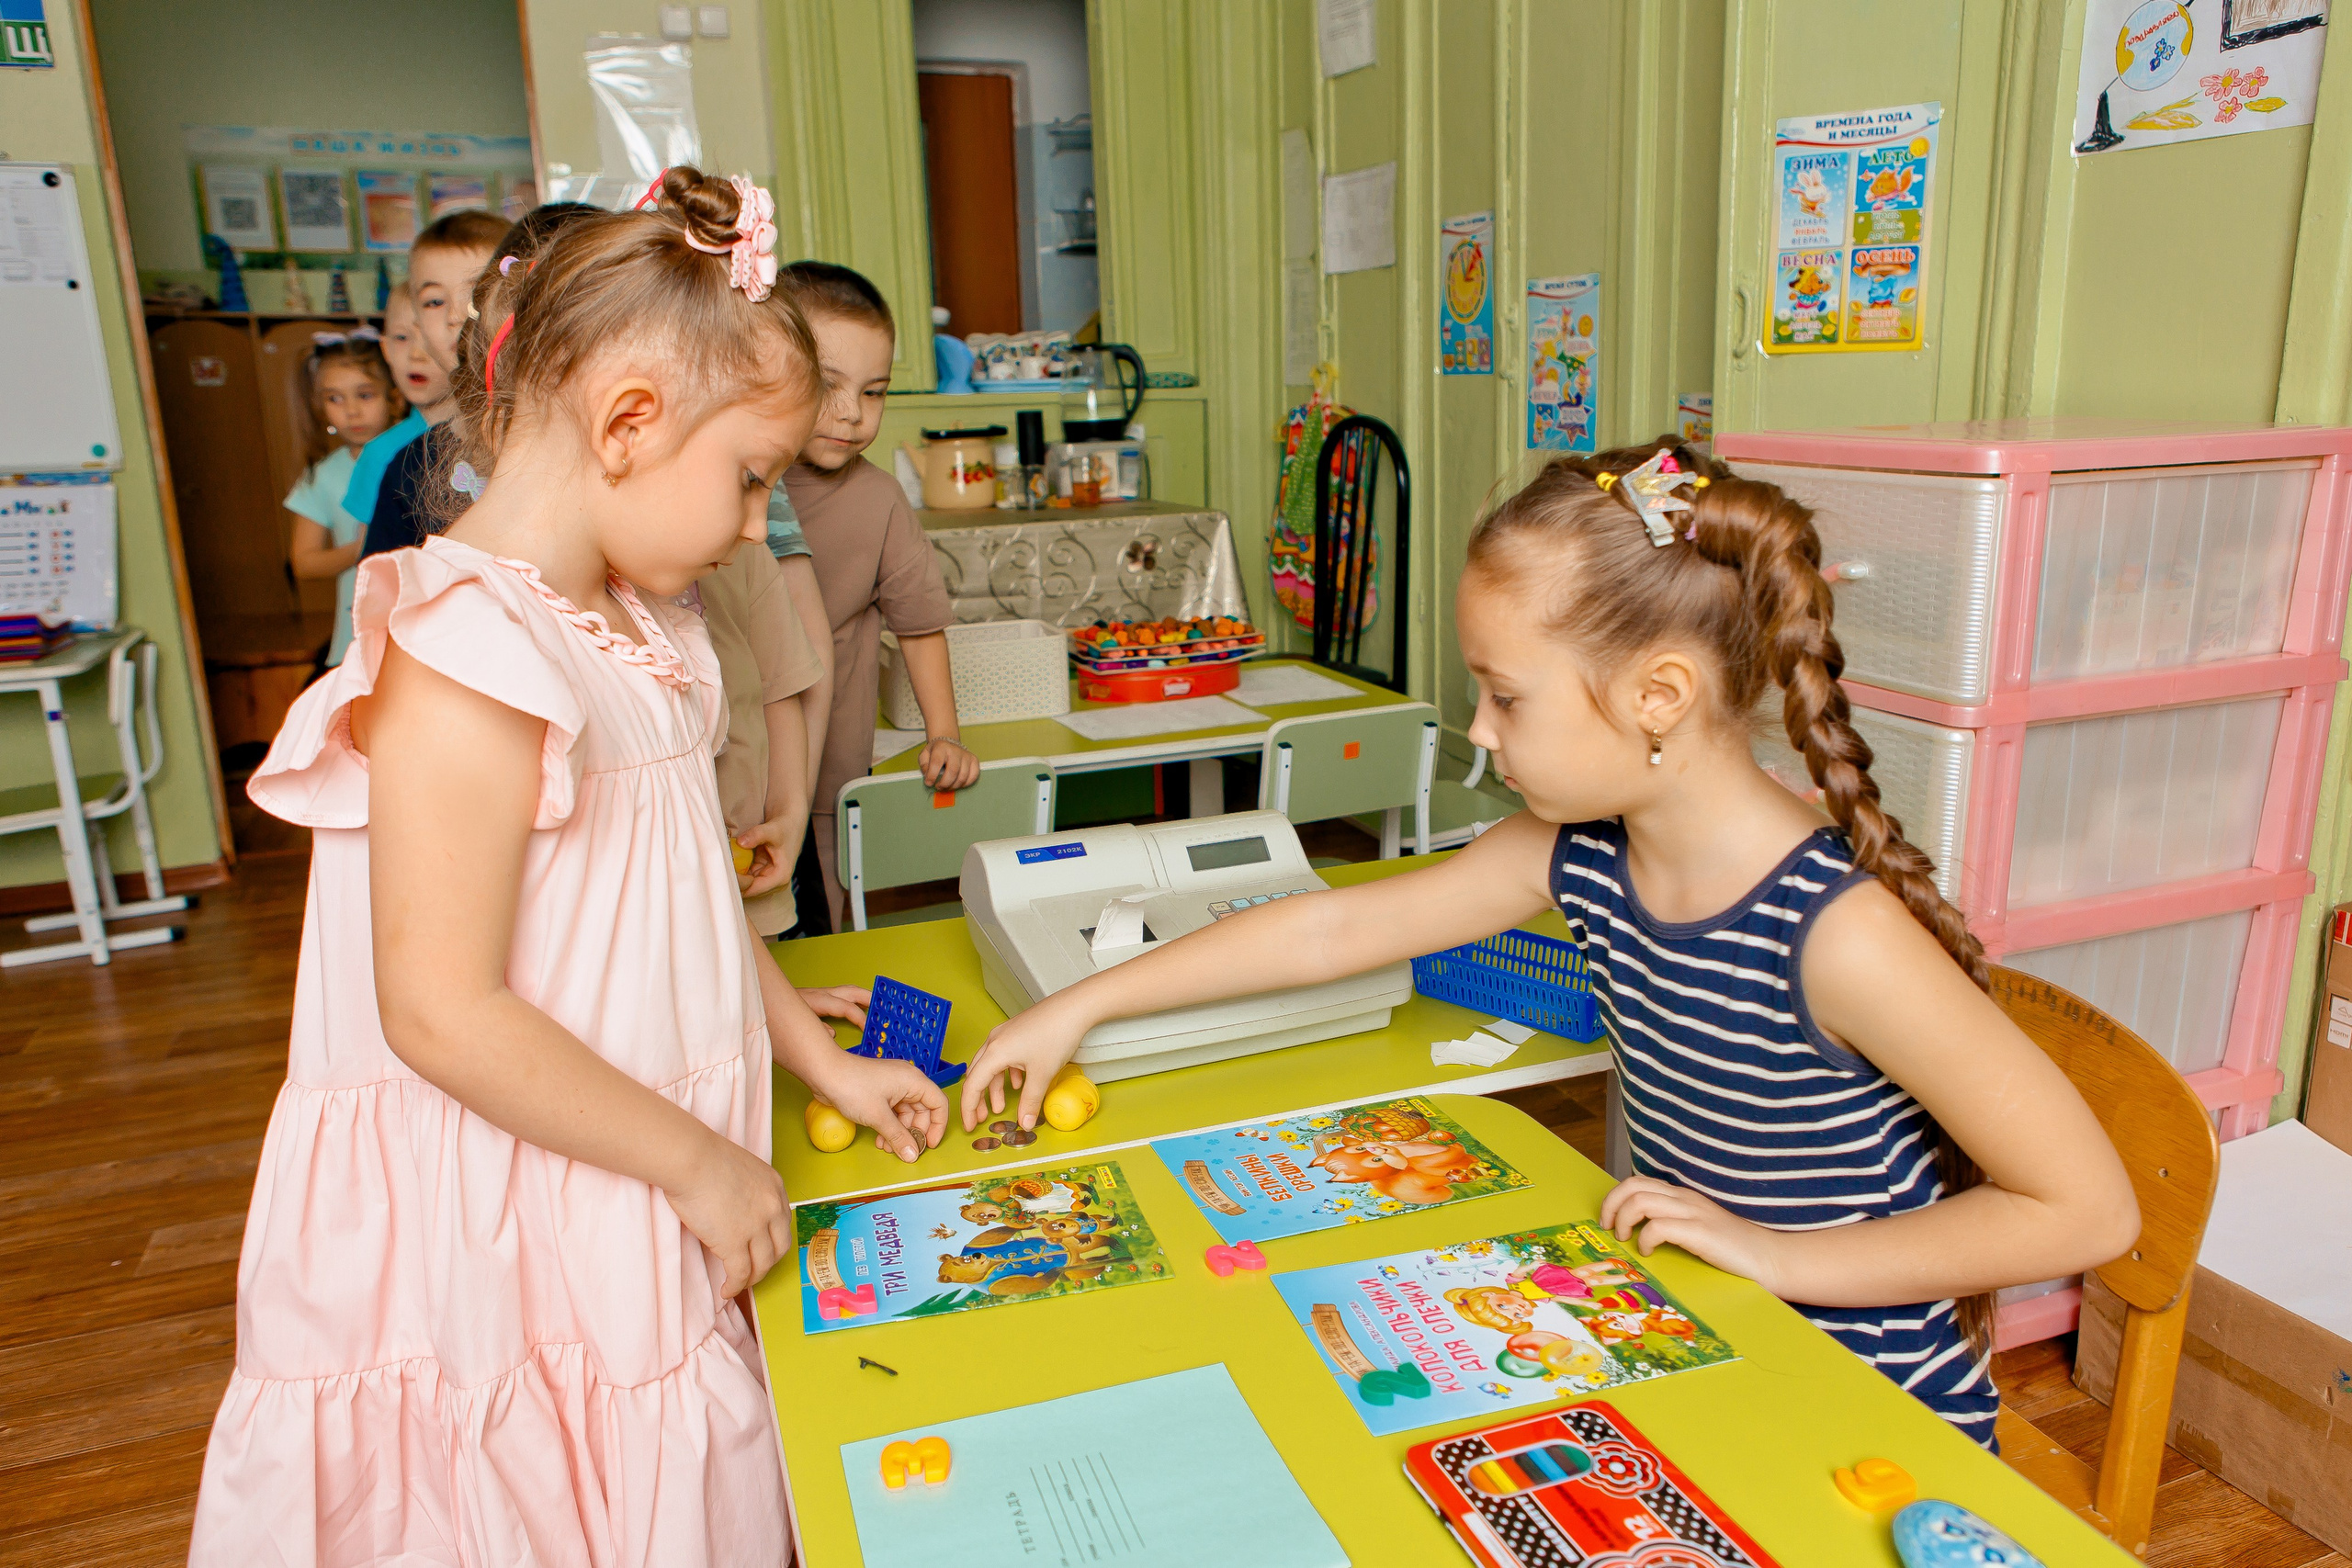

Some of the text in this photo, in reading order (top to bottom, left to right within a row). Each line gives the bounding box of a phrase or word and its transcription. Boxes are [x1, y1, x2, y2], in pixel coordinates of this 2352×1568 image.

[1815, 111, 1913, 130] ВРЕМЕНА ГОДА
[1828, 126, 1897, 141] И МЕСЯЦЫ
[1792, 155, 1838, 171] ЗИМА
[1868, 151, 1915, 166] ЛЕТО
[1781, 254, 1836, 267] ВЕСНА
[1856, 248, 1916, 265] ОСЕНЬ
[1057, 846, 1082, 854] 2102К
[1234, 1153, 1294, 1202] БЕЛКИНЫ
[1264, 1152, 1317, 1192] ОРЕШКИ
[851, 1236, 868, 1276] ЛЕВ ТОЛСТОЙ
[872, 1212, 910, 1296] ТРИ МЕДВЕДЯ
[1347, 1301, 1385, 1346] АЛЕКСАНДРОВА
[1355, 1277, 1466, 1394] КОЛОКОЛЬЧИКИ
[1394, 1280, 1488, 1373] ДЛЯ ОЛЕЧКИ
[1005, 1491, 1036, 1554] ТЕТРАДЬ
[1623, 1516, 1654, 1540] 12
